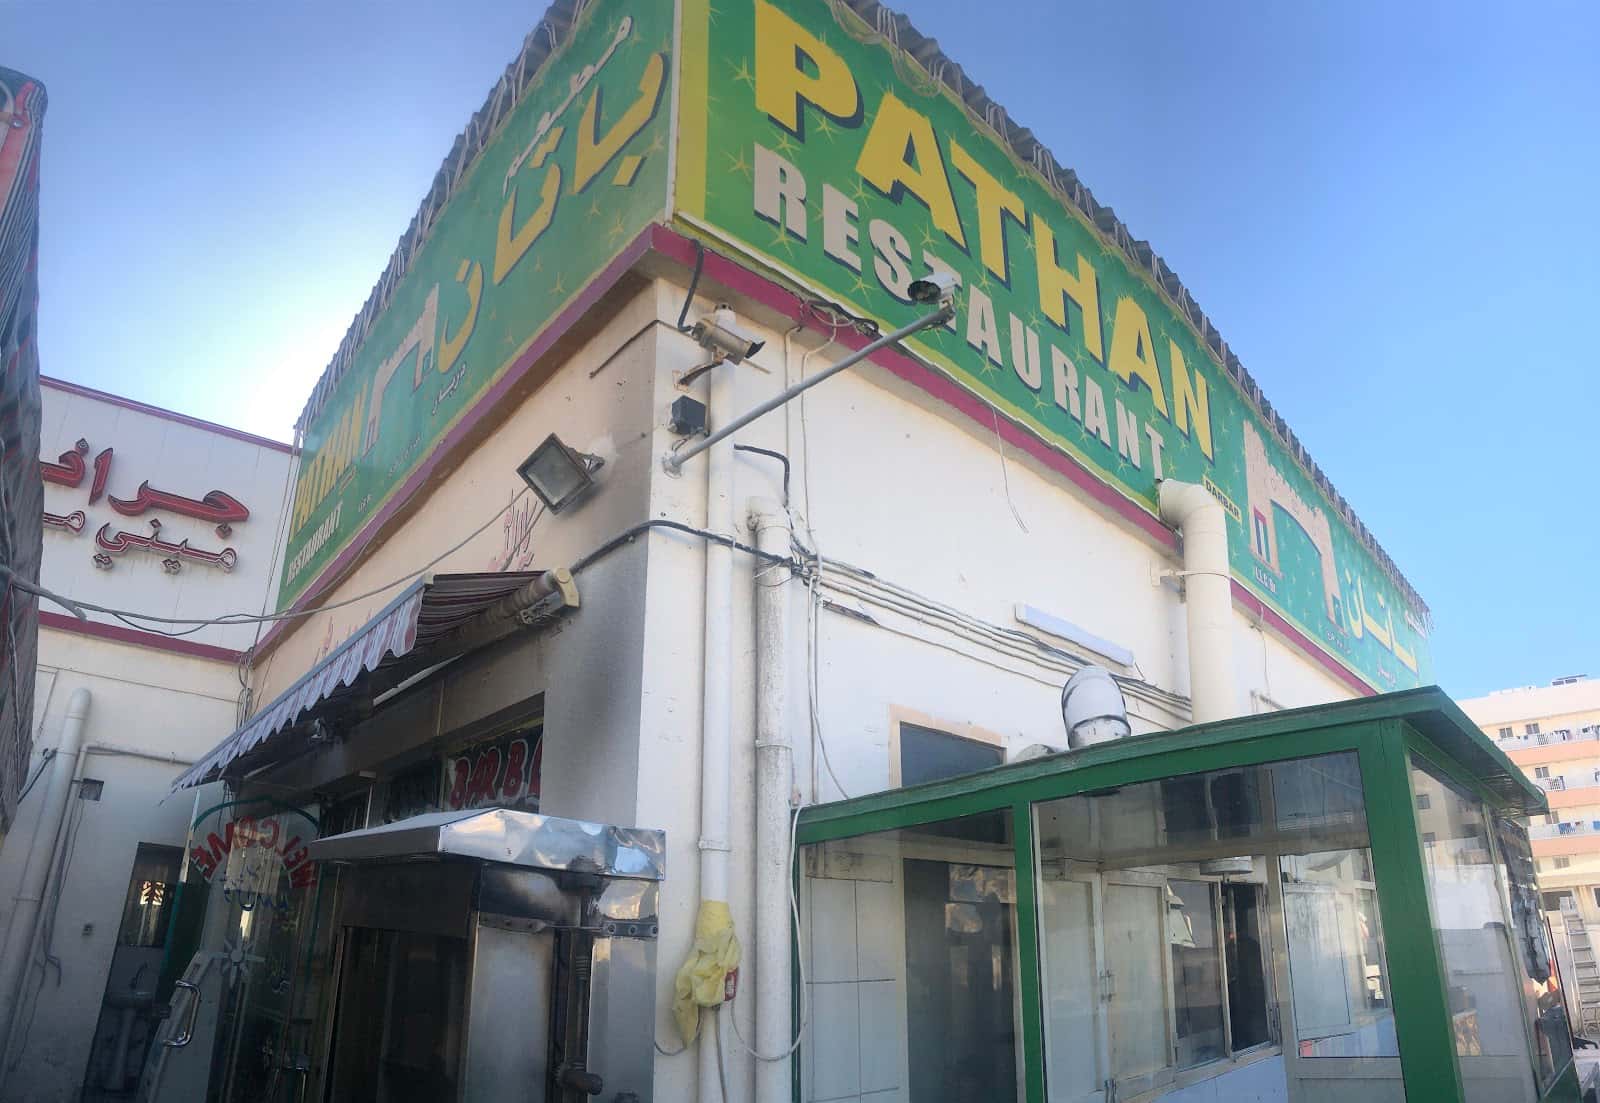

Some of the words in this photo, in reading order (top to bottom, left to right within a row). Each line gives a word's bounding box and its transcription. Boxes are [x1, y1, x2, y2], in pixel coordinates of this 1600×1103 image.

[437, 52, 665, 375] باتان
[753, 142, 1165, 482] RESTAURANT
[754, 0, 1214, 463] PATHAN
[287, 500, 344, 587] RESTAURANT
